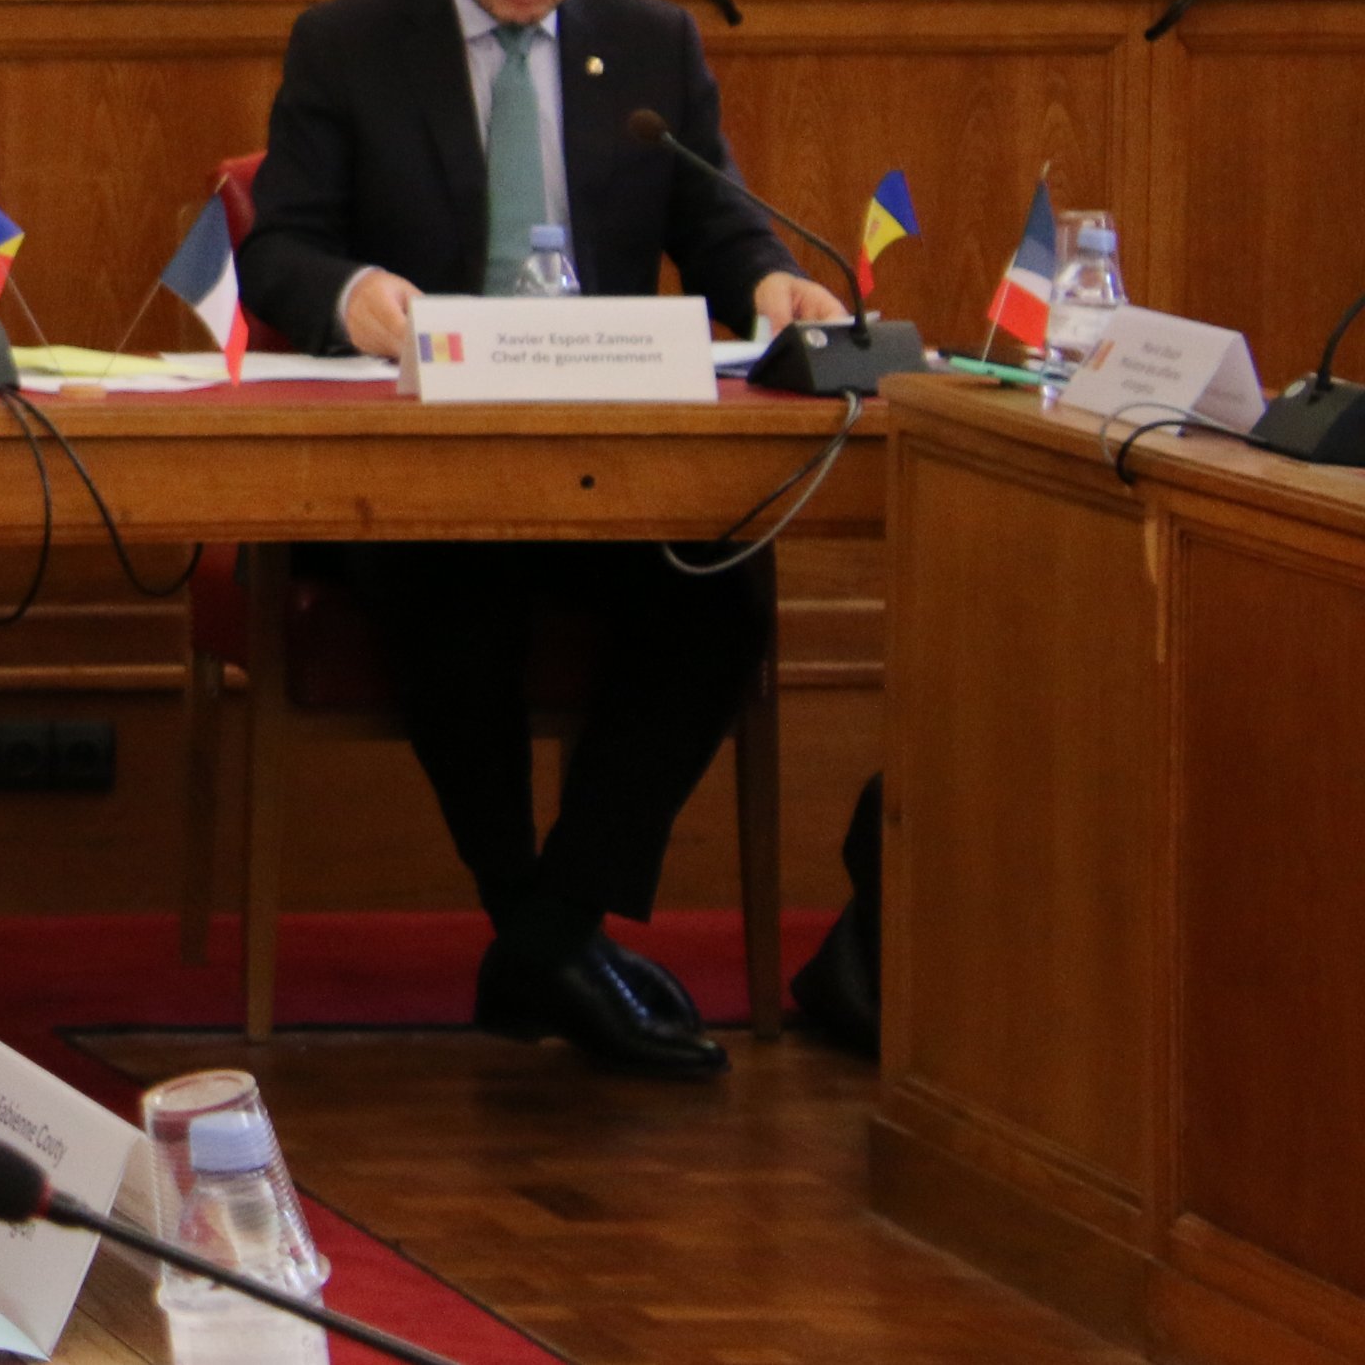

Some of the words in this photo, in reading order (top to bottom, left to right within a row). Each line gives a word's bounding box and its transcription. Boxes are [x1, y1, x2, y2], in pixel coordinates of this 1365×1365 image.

[497, 333, 544, 346] Xavier
[549, 333, 591, 348] Espot
[596, 333, 654, 346] Zamora
[491, 350, 527, 364] Chef
[531, 350, 552, 364] de
[555, 351, 664, 367] gouvernement
